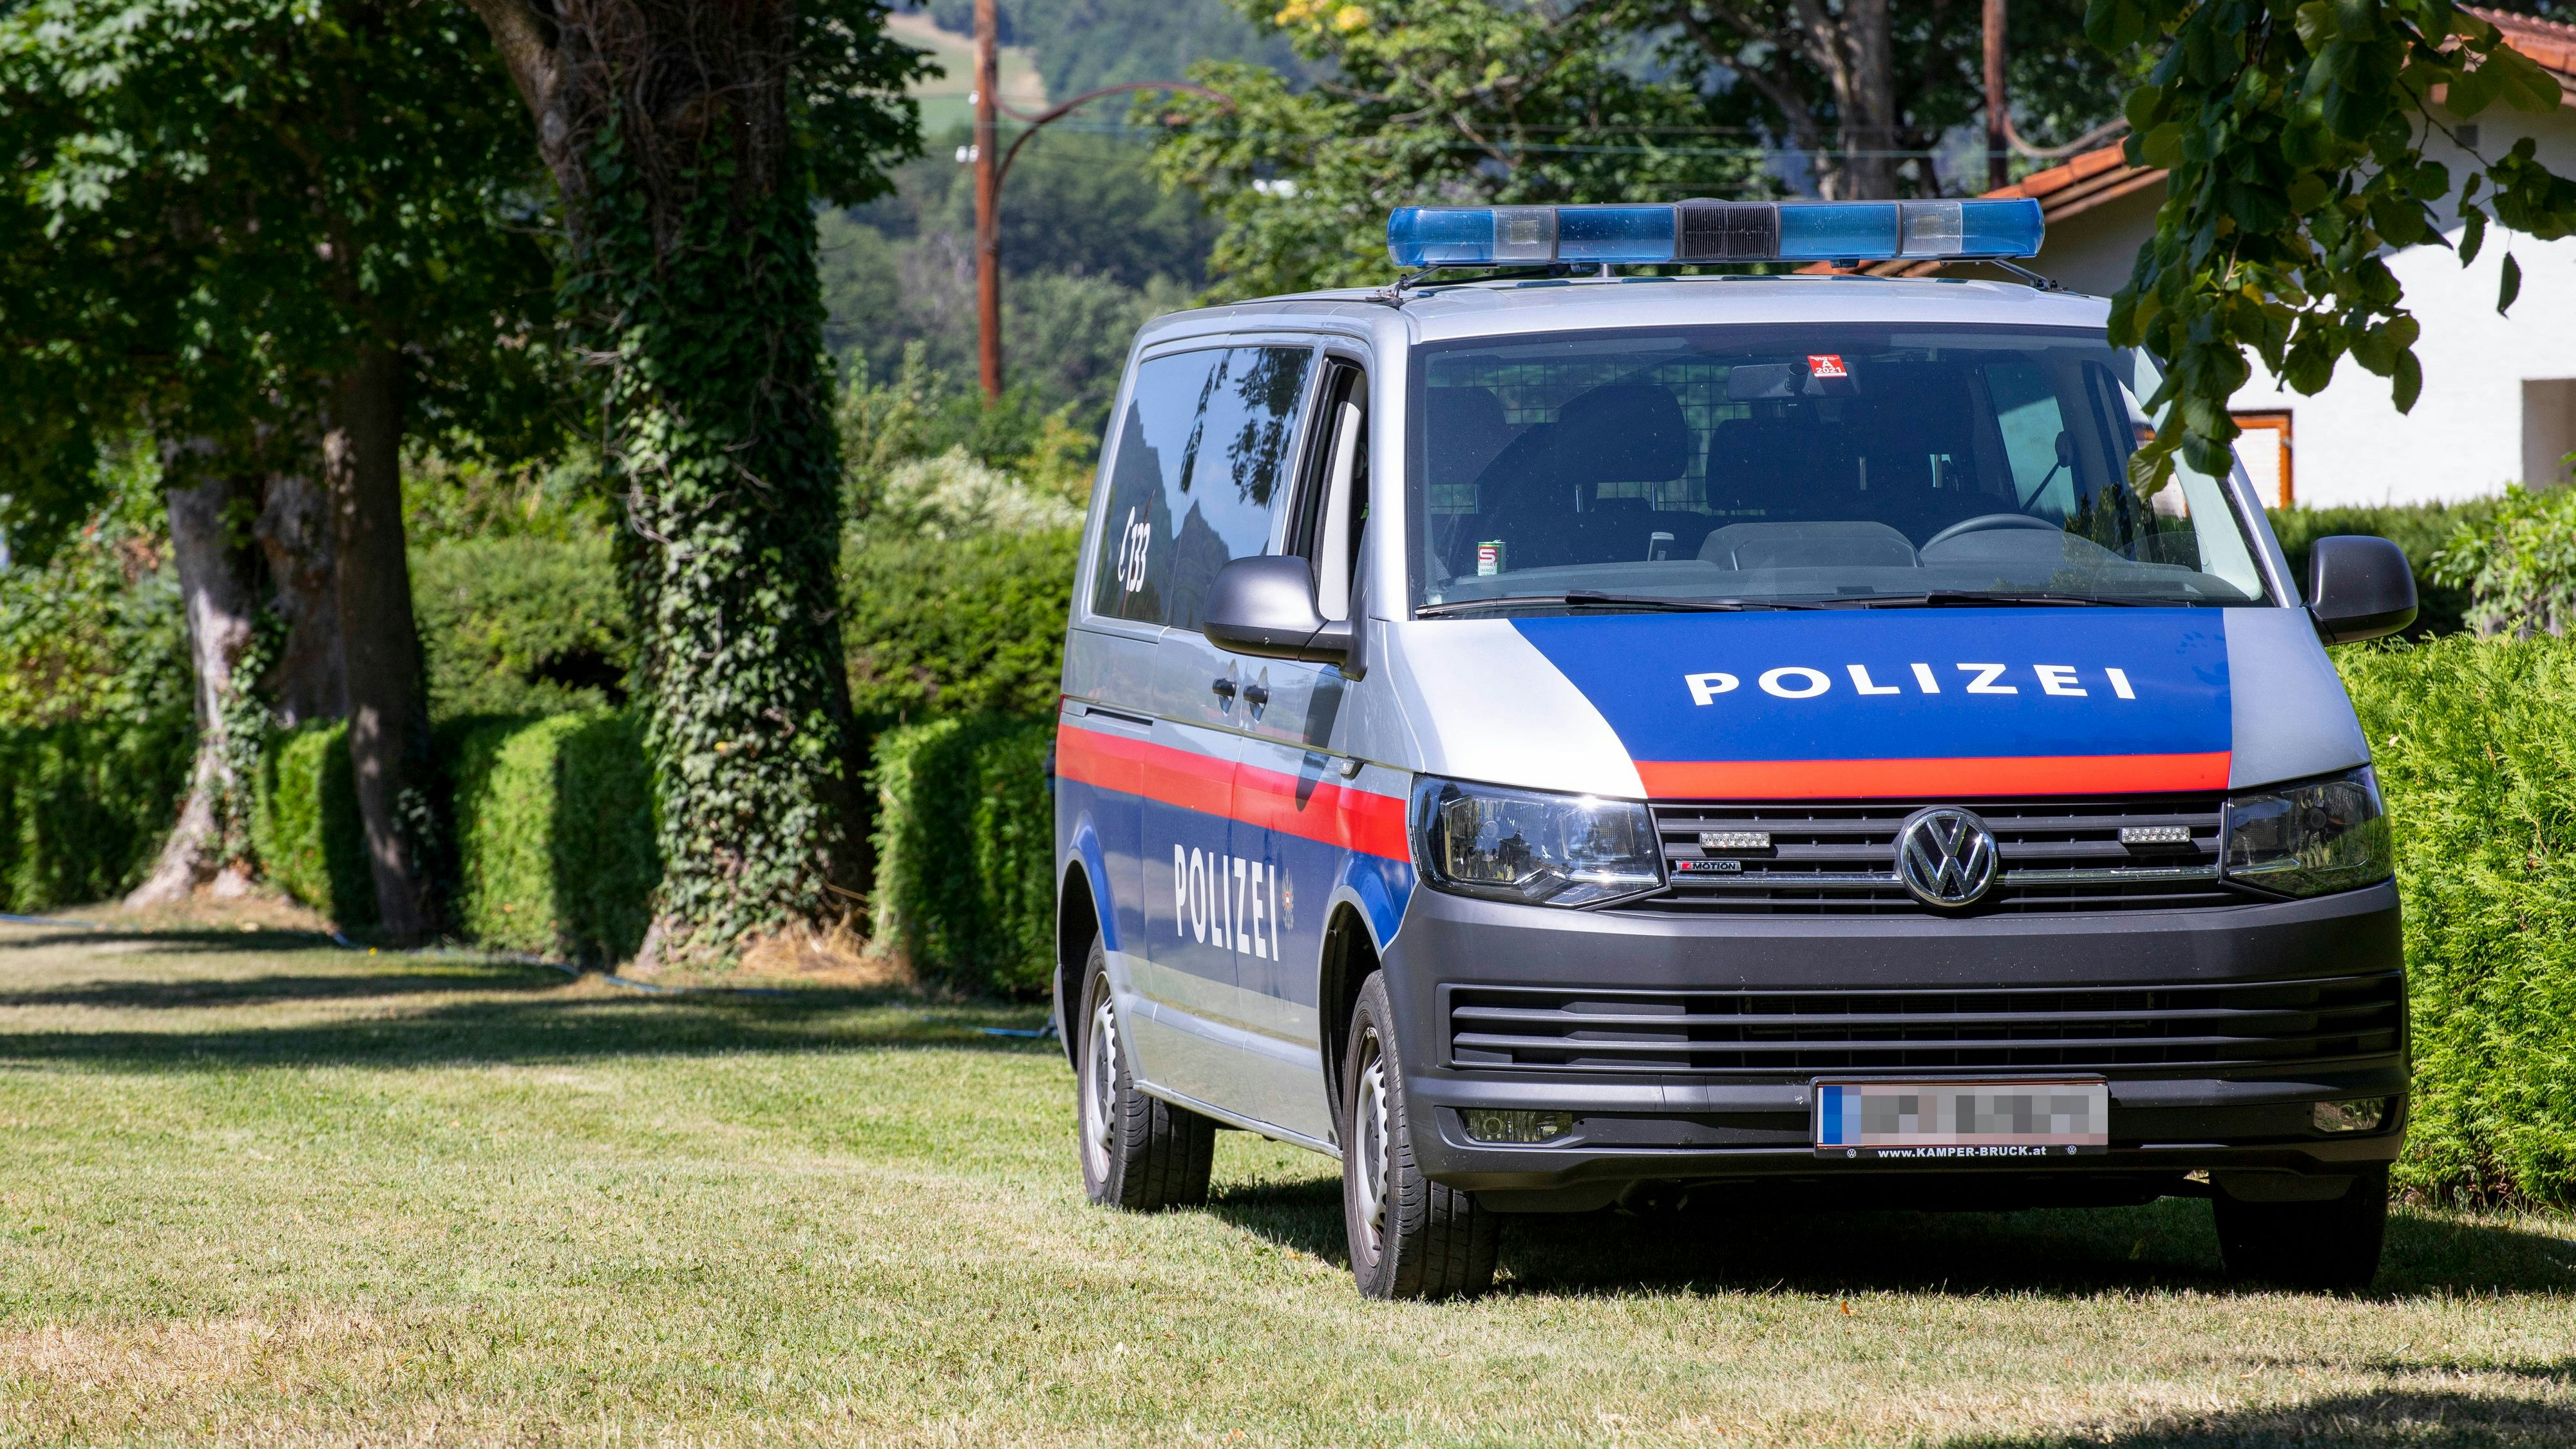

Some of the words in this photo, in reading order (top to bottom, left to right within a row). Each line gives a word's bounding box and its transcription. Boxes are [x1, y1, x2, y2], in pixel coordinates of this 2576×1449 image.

[1125, 522, 1151, 592] 133
[1684, 663, 2136, 706] POLIZEI
[1174, 844, 1279, 962] POLIZEI
[1878, 1146, 2047, 1158] www.KAMPER-BRUCK.at
